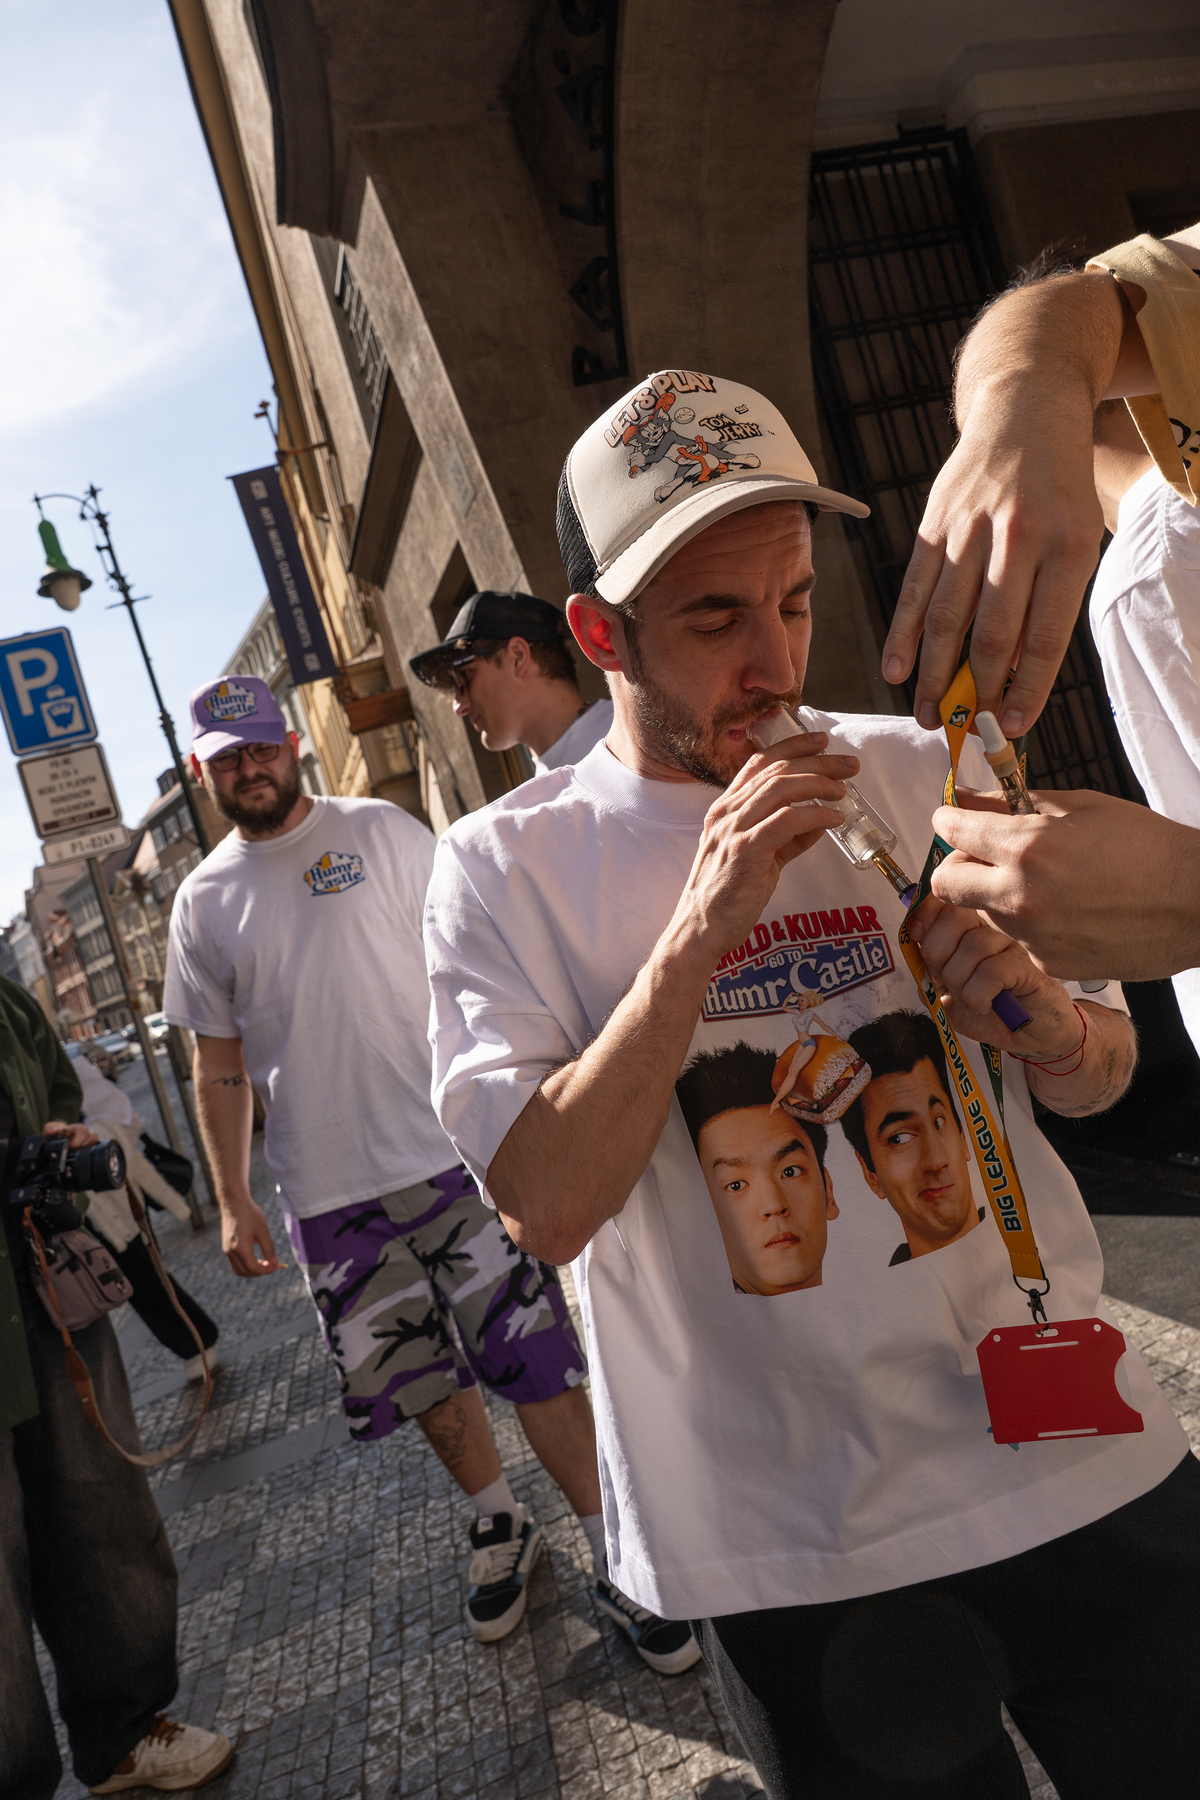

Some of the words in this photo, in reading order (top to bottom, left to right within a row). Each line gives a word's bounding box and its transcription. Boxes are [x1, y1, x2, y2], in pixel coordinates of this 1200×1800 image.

[651, 371, 717, 397] PLAY
[698, 413, 736, 433] TOM
[714, 420, 763, 442] JERRY
[259, 506, 276, 527] ART
[278, 560, 301, 607] CULTURE
[292, 607, 313, 648] EVENTS
[209, 693, 249, 709] Humr
[211, 703, 256, 719] Castle
[310, 861, 354, 881] Humr
[312, 871, 361, 893] Castle
[768, 956, 785, 969] GO
[784, 950, 802, 964] TO
[706, 977, 788, 1015] Humr
[789, 942, 886, 1004] Castle
[936, 1006, 974, 1099] SMOKE
[968, 1098, 1009, 1193] LEAGUE
[996, 1193, 1024, 1233] BIG
